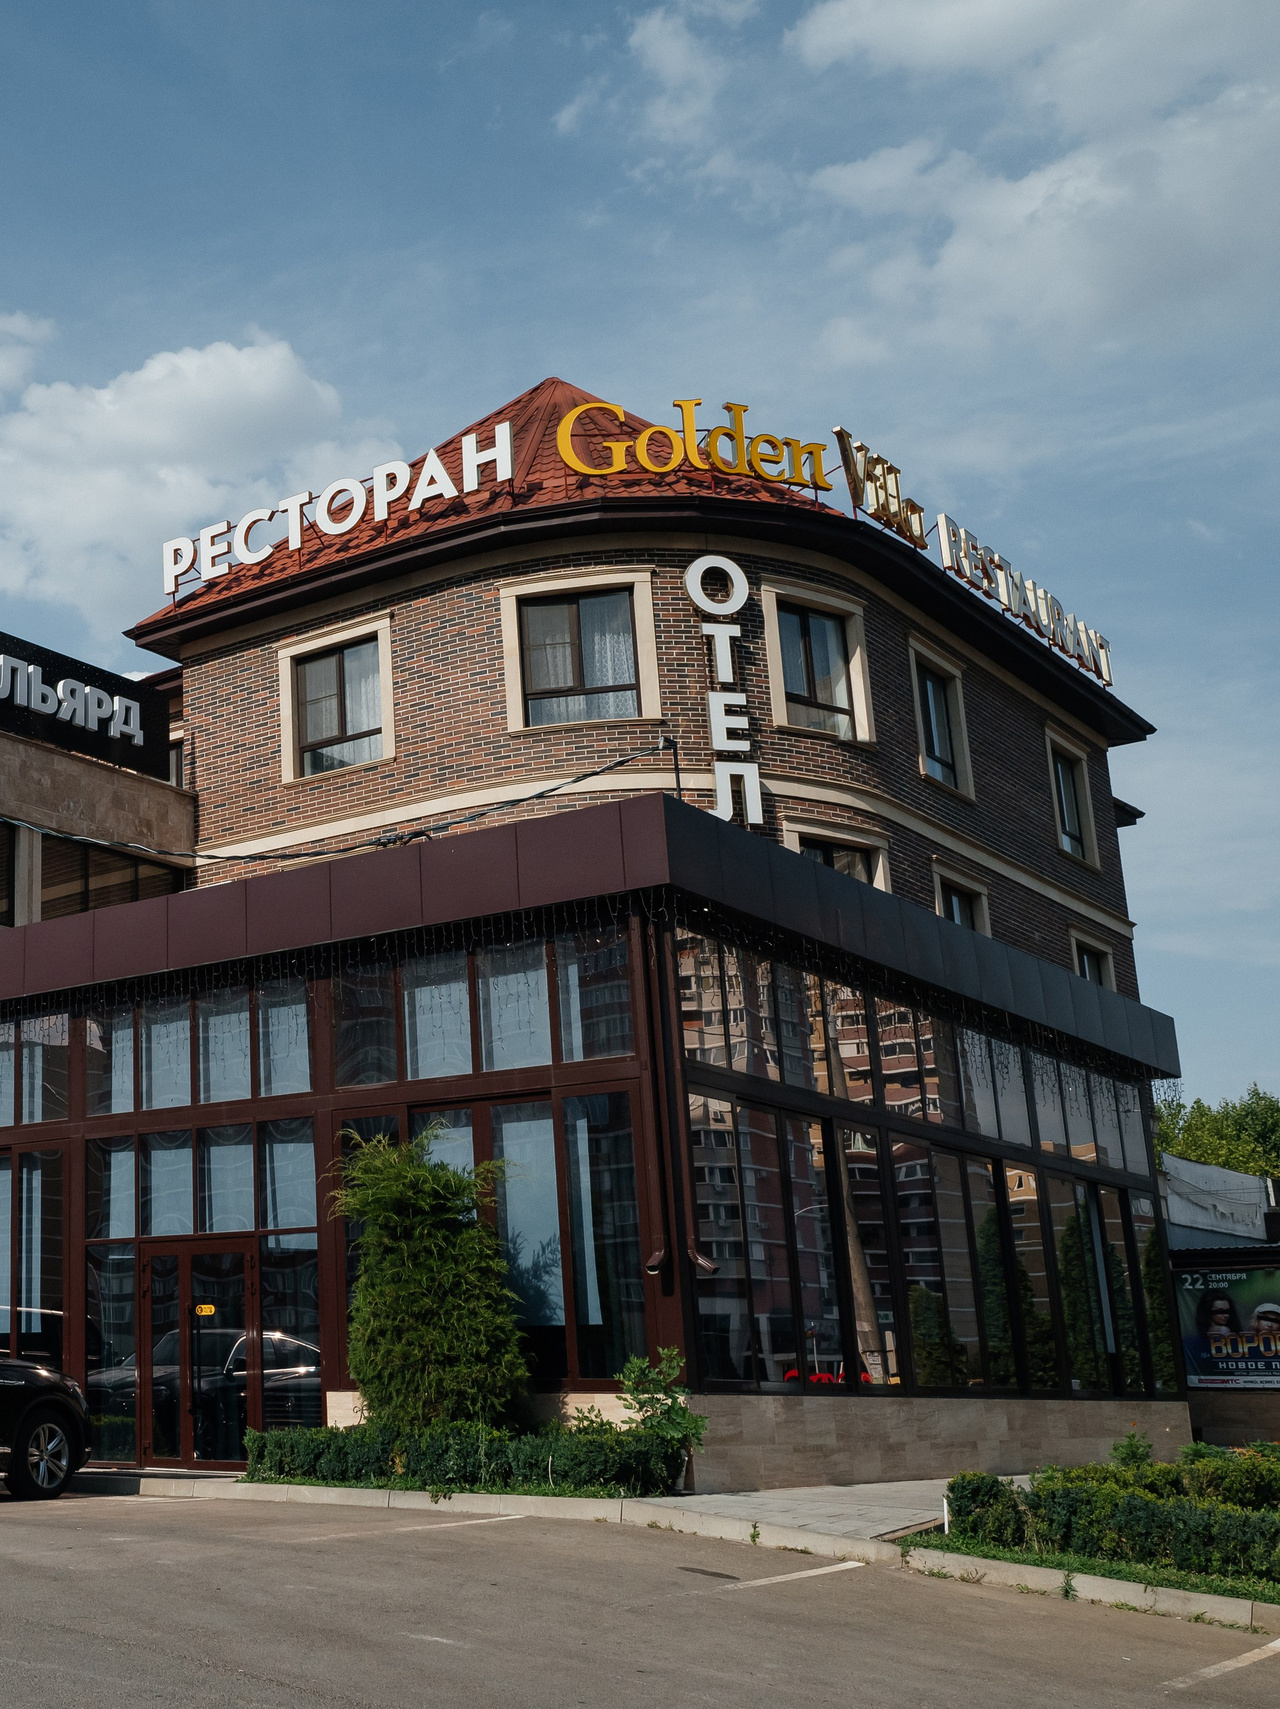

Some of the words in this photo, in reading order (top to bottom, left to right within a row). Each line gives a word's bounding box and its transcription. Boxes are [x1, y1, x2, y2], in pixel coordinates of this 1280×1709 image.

[162, 420, 514, 596] РЕСТОРАН
[556, 398, 833, 492] Golden
[831, 425, 930, 550] Villa
[936, 512, 1115, 688] RESTAURANT
[683, 554, 763, 825] ОТЕЛ
[1181, 1273, 1205, 1289] 22
[1207, 1273, 1247, 1281] СЕНТЯБРЯ
[1218, 1361, 1266, 1369] НОВОЕ
